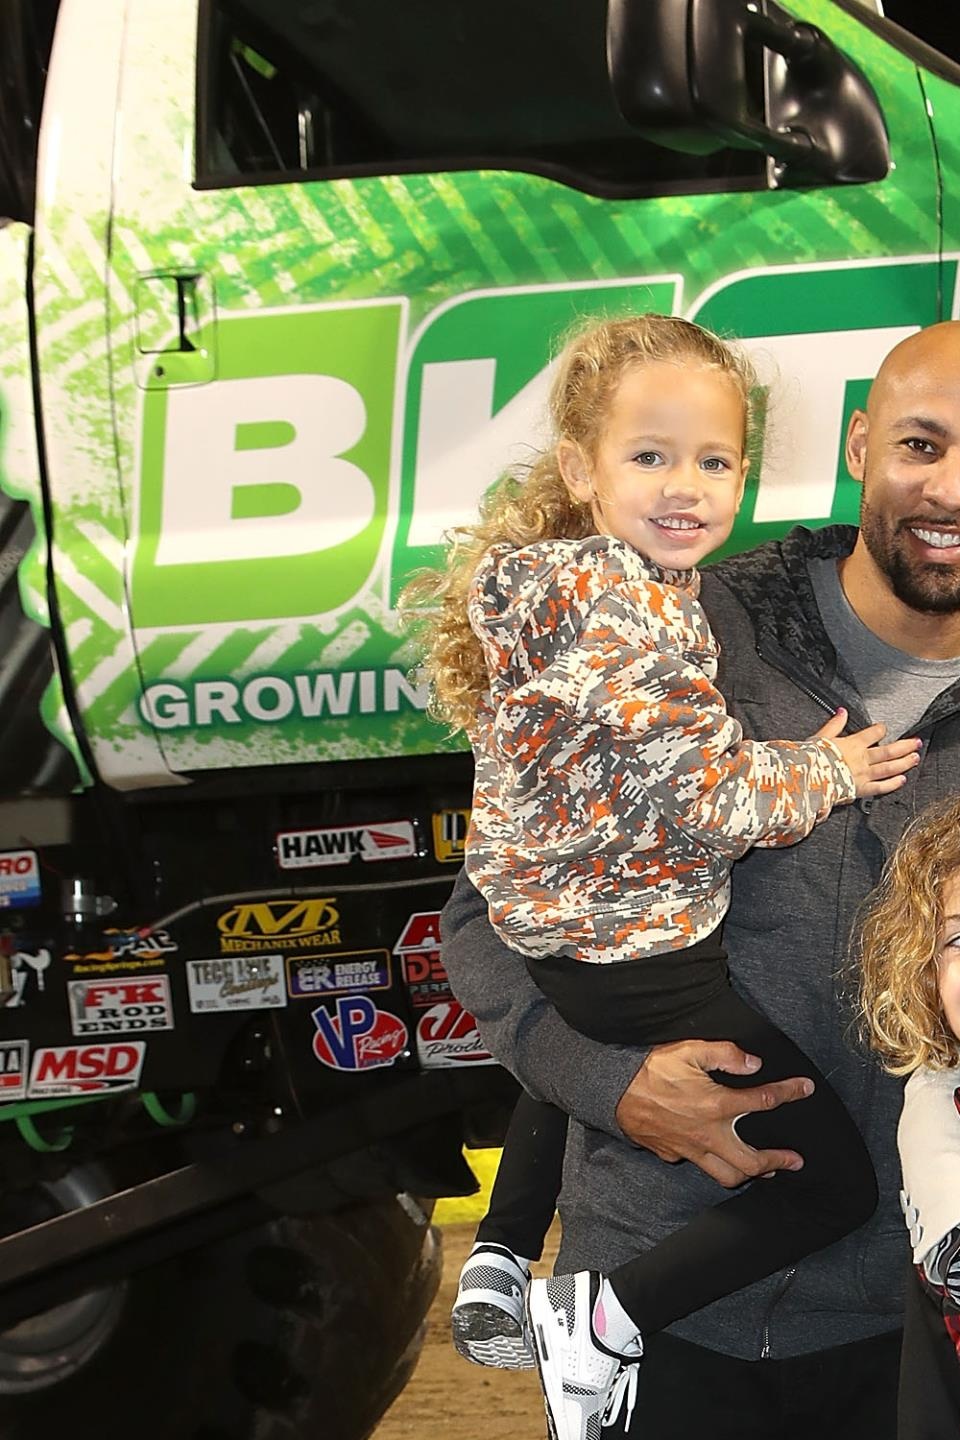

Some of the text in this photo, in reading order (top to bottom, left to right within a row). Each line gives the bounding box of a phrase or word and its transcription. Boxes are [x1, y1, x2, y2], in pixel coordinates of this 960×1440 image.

[140, 668, 431, 729] GROWIN
[281, 830, 367, 859] HAWK
[220, 929, 342, 953] MECHANIX WEAR
[335, 960, 378, 975] ENERGY
[335, 972, 381, 987] RELEASE
[84, 983, 164, 1007] FK
[97, 1005, 166, 1019] ROD
[78, 1017, 168, 1033] ENDS
[312, 996, 376, 1070] VP
[358, 1029, 401, 1060] Racing
[36, 1045, 139, 1082] MSD
